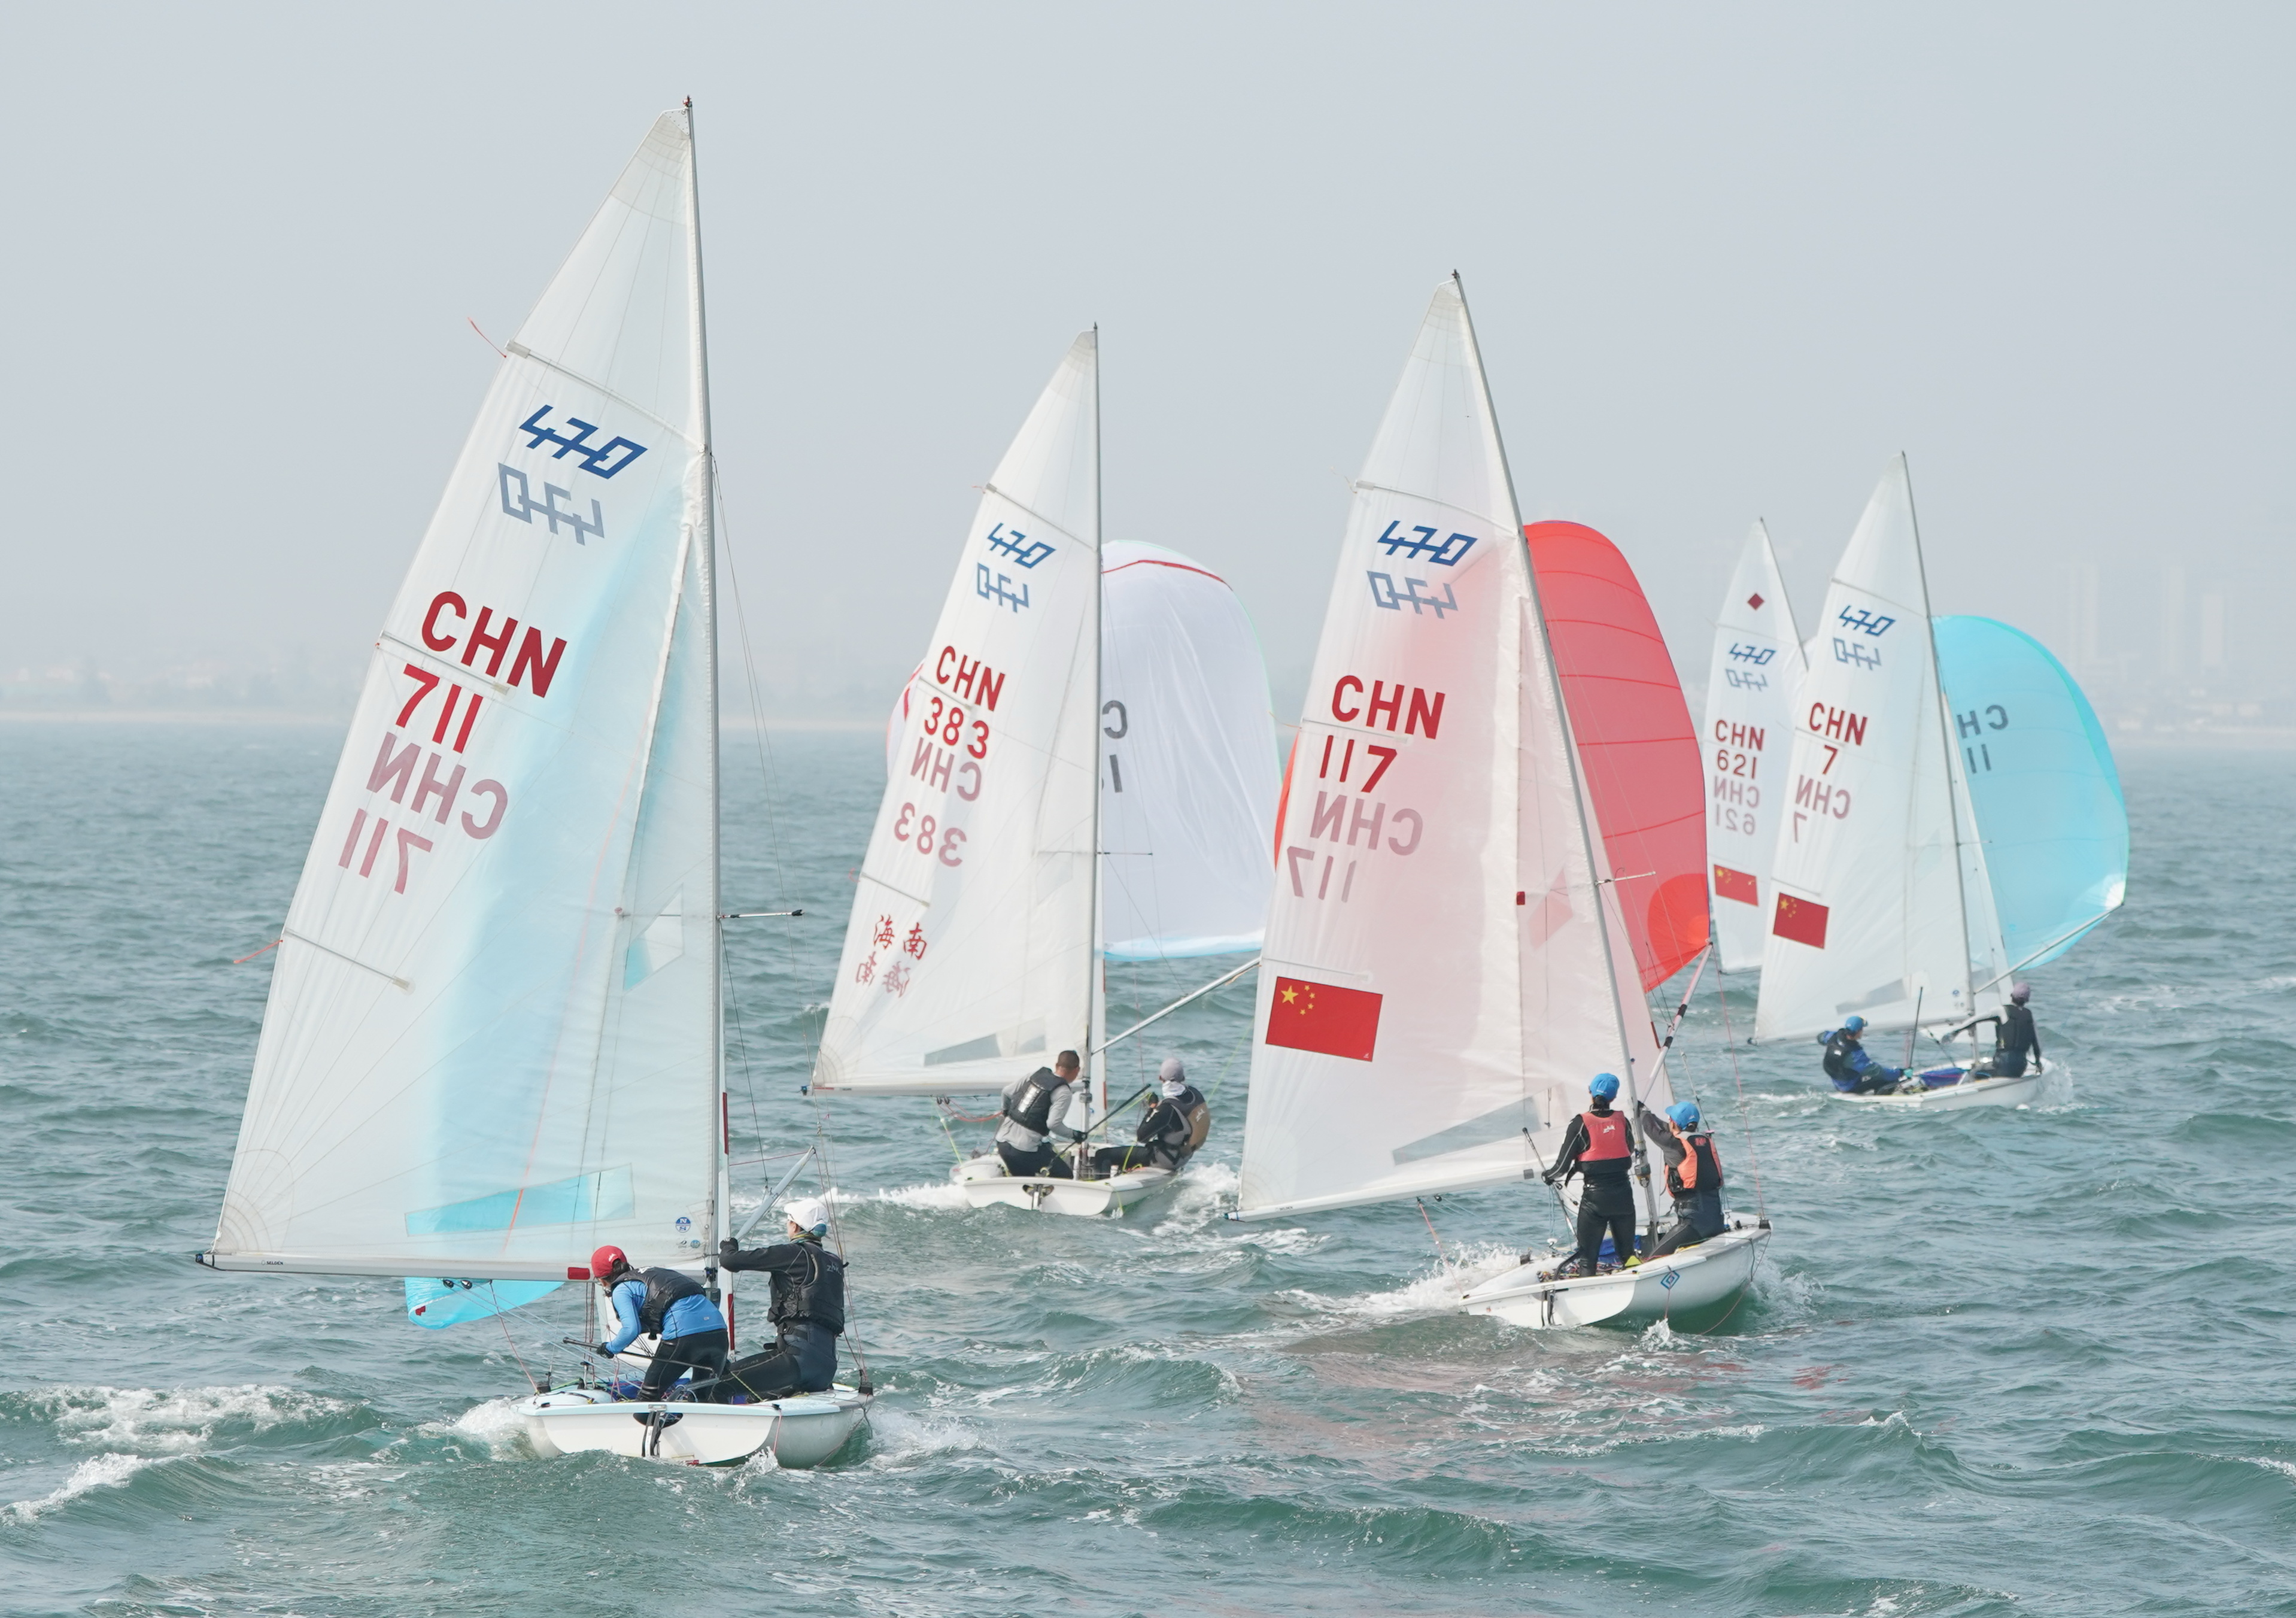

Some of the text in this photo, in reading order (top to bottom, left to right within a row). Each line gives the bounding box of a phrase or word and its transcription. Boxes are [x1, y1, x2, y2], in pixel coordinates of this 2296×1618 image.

[518, 404, 648, 479] 470
[987, 523, 1056, 569] 470
[1377, 520, 1478, 567] 470
[1839, 605, 1896, 637] 470
[421, 591, 567, 698] CHN
[1729, 643, 1776, 666] 470
[936, 645, 1006, 712] CHN
[395, 663, 484, 754] 711
[924, 696, 989, 759] 383
[1332, 675, 1445, 740] CHN
[1809, 702, 1867, 746] CHN
[1715, 720, 1764, 751] CHN
[1319, 734, 1398, 793] 117
[1717, 749, 1757, 779] 621
[1823, 745, 1838, 775] 7
[874, 915, 927, 960] 海南
